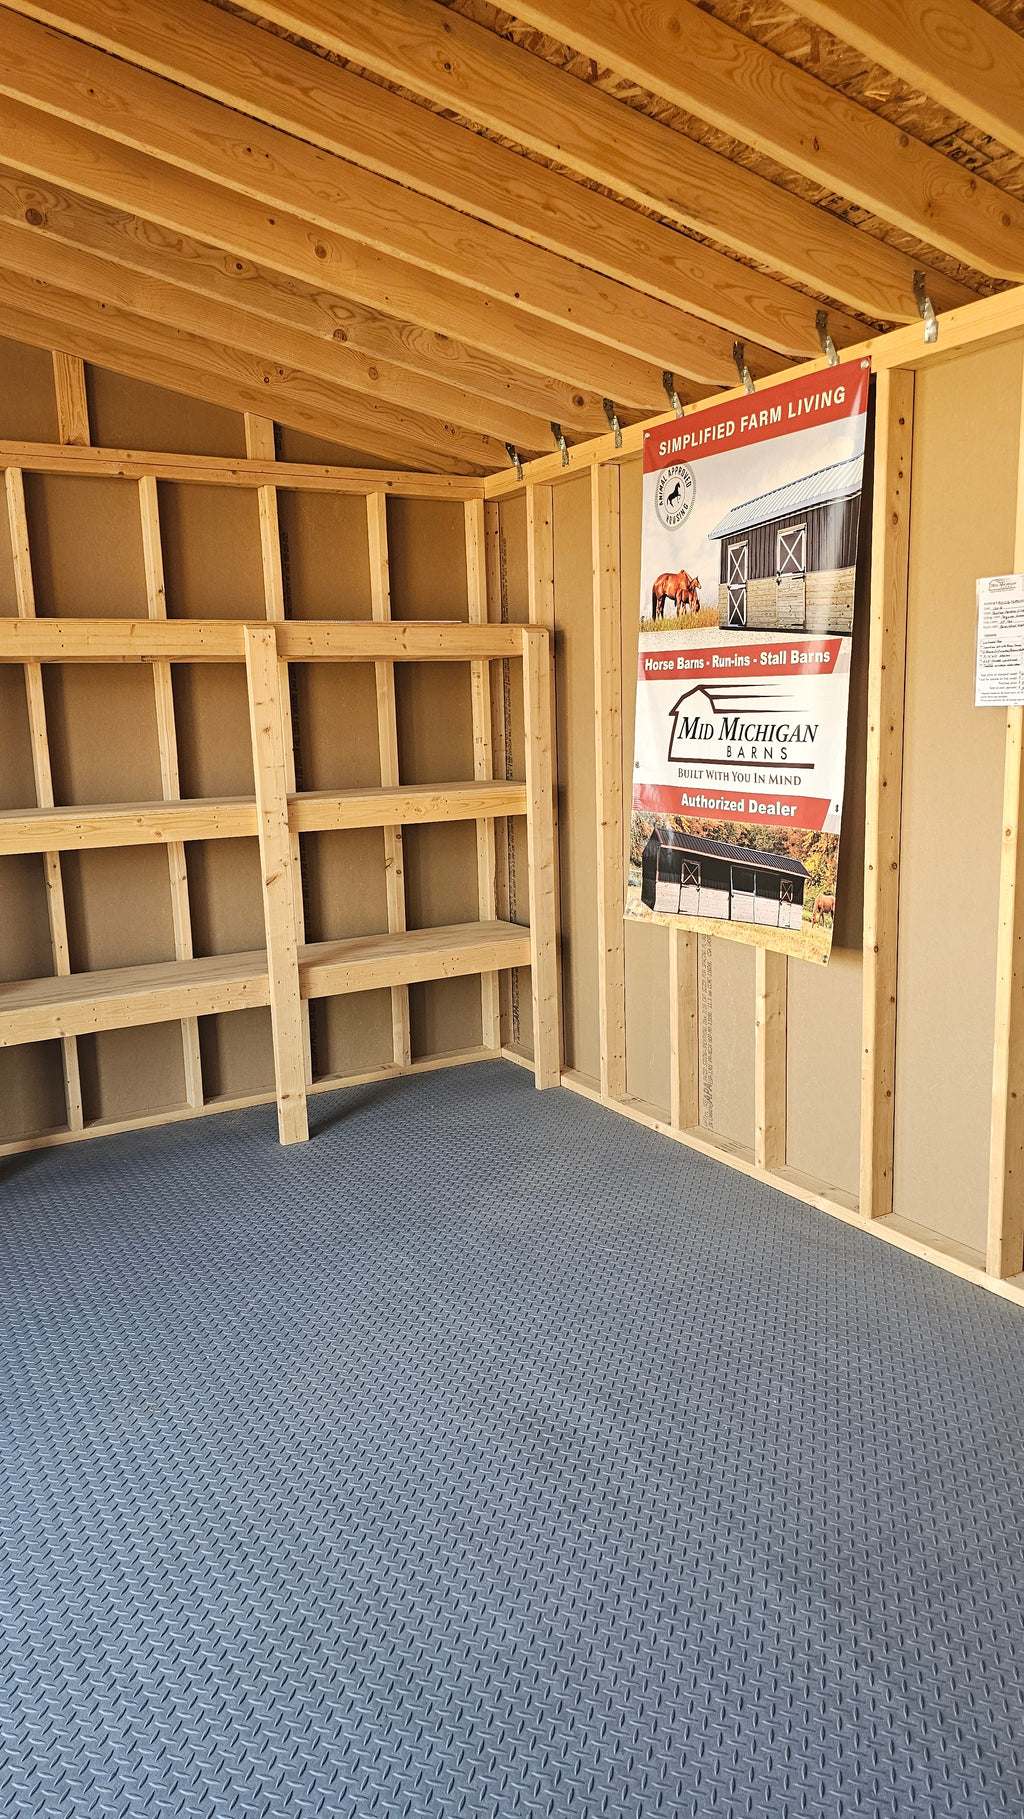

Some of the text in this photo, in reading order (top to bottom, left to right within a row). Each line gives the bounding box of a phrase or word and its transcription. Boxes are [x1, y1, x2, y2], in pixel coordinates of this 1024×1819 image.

[658, 386, 846, 456] SIMPLIFIED FARM LIVING
[668, 466, 692, 488] APPROVED
[644, 658, 674, 671] Horse
[677, 657, 704, 670] Barns
[712, 654, 750, 668] Run-ins
[760, 650, 786, 665] Stall
[790, 650, 830, 664] Barns
[726, 745, 788, 760] BARNS
[681, 793, 797, 817] Authorized Dealer
